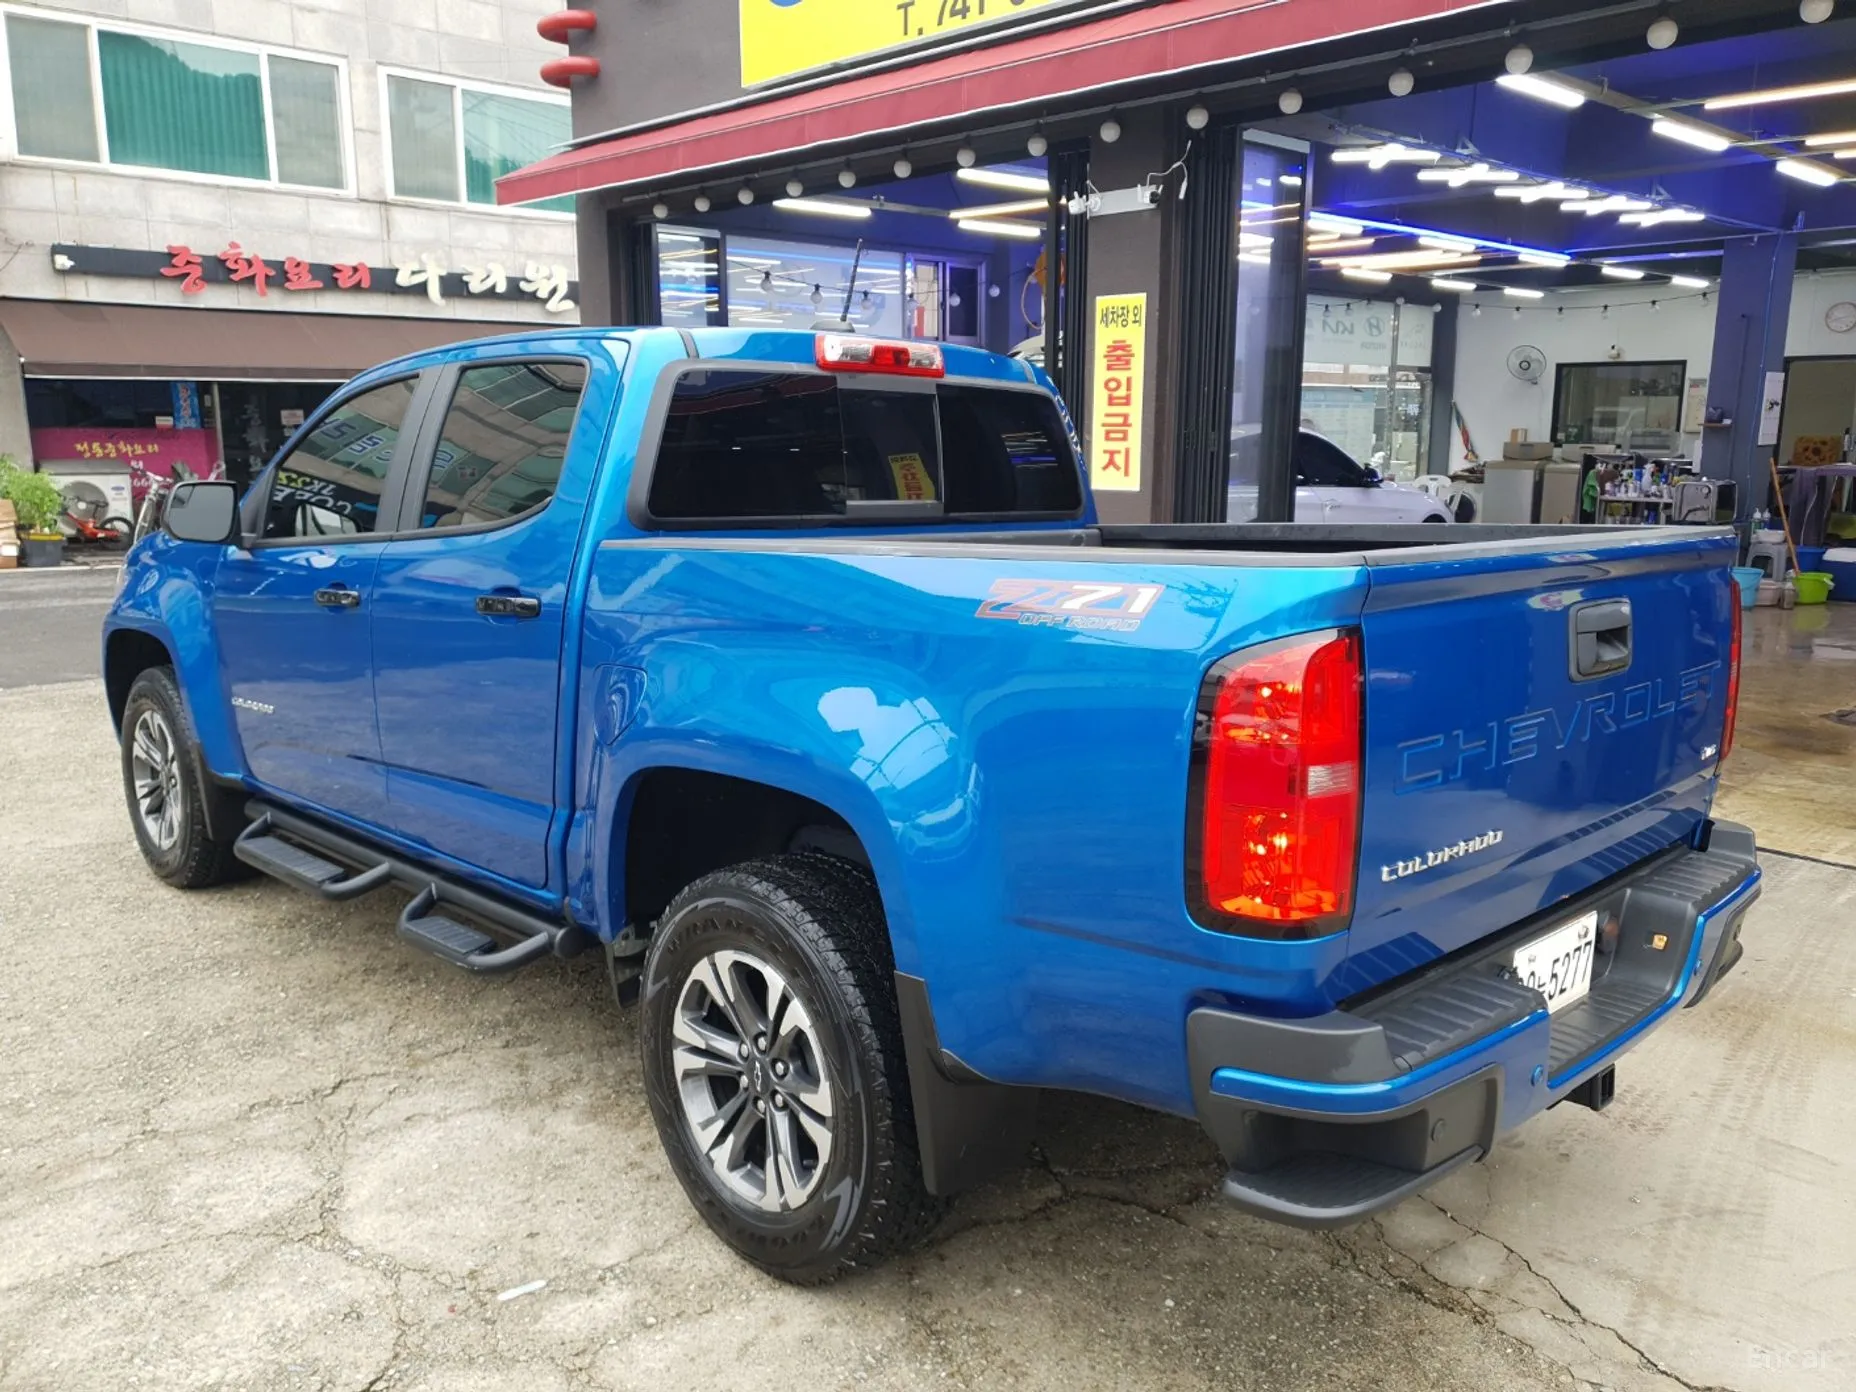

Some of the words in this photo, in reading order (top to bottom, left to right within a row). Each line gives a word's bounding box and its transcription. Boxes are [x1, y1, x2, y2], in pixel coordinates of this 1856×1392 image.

[160, 241, 371, 297] 중화요리
[1100, 305, 1129, 329] 세차장
[1132, 304, 1142, 327] 외
[1102, 340, 1135, 477] 출입금지
[975, 578, 1166, 620] Z71
[1394, 661, 1721, 795] CHEVROLET
[1381, 828, 1503, 882] COLORADO
